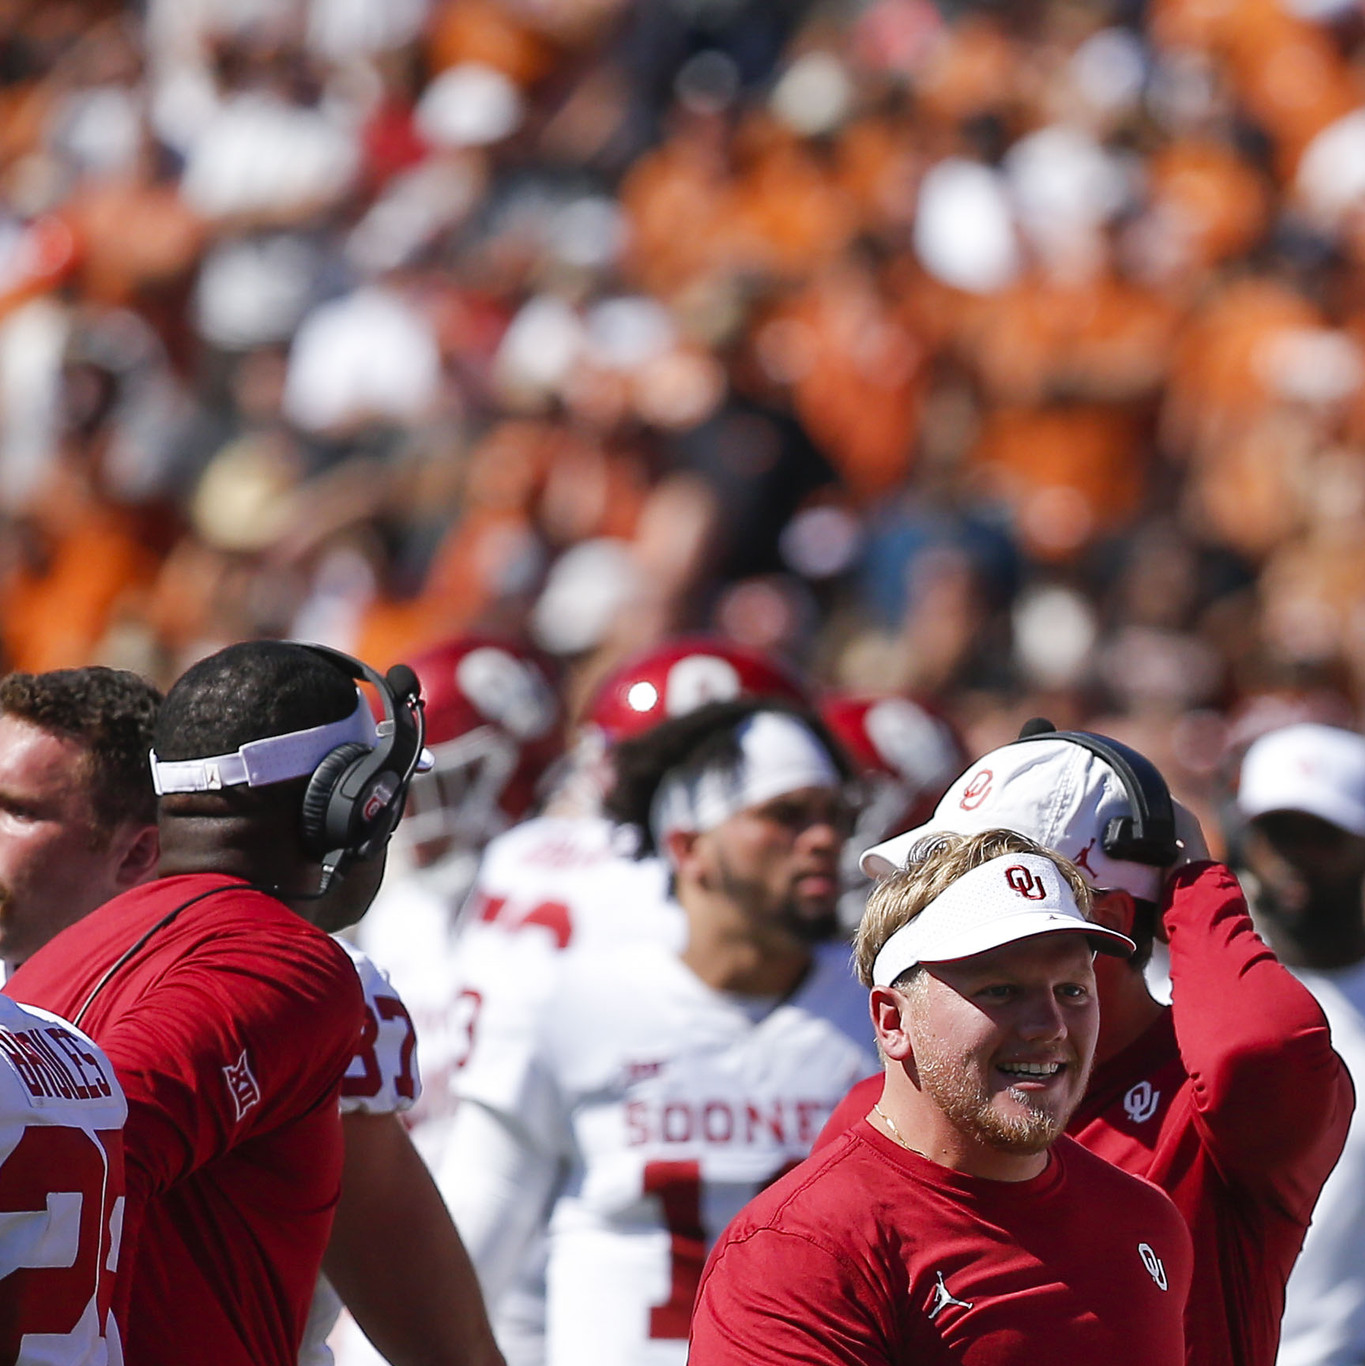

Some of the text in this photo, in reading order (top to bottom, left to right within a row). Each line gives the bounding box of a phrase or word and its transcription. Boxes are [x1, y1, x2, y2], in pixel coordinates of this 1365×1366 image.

[959, 769, 993, 812] OU
[1004, 864, 1047, 901] OU
[1123, 1080, 1161, 1124] OU
[1138, 1243, 1168, 1292] OU
